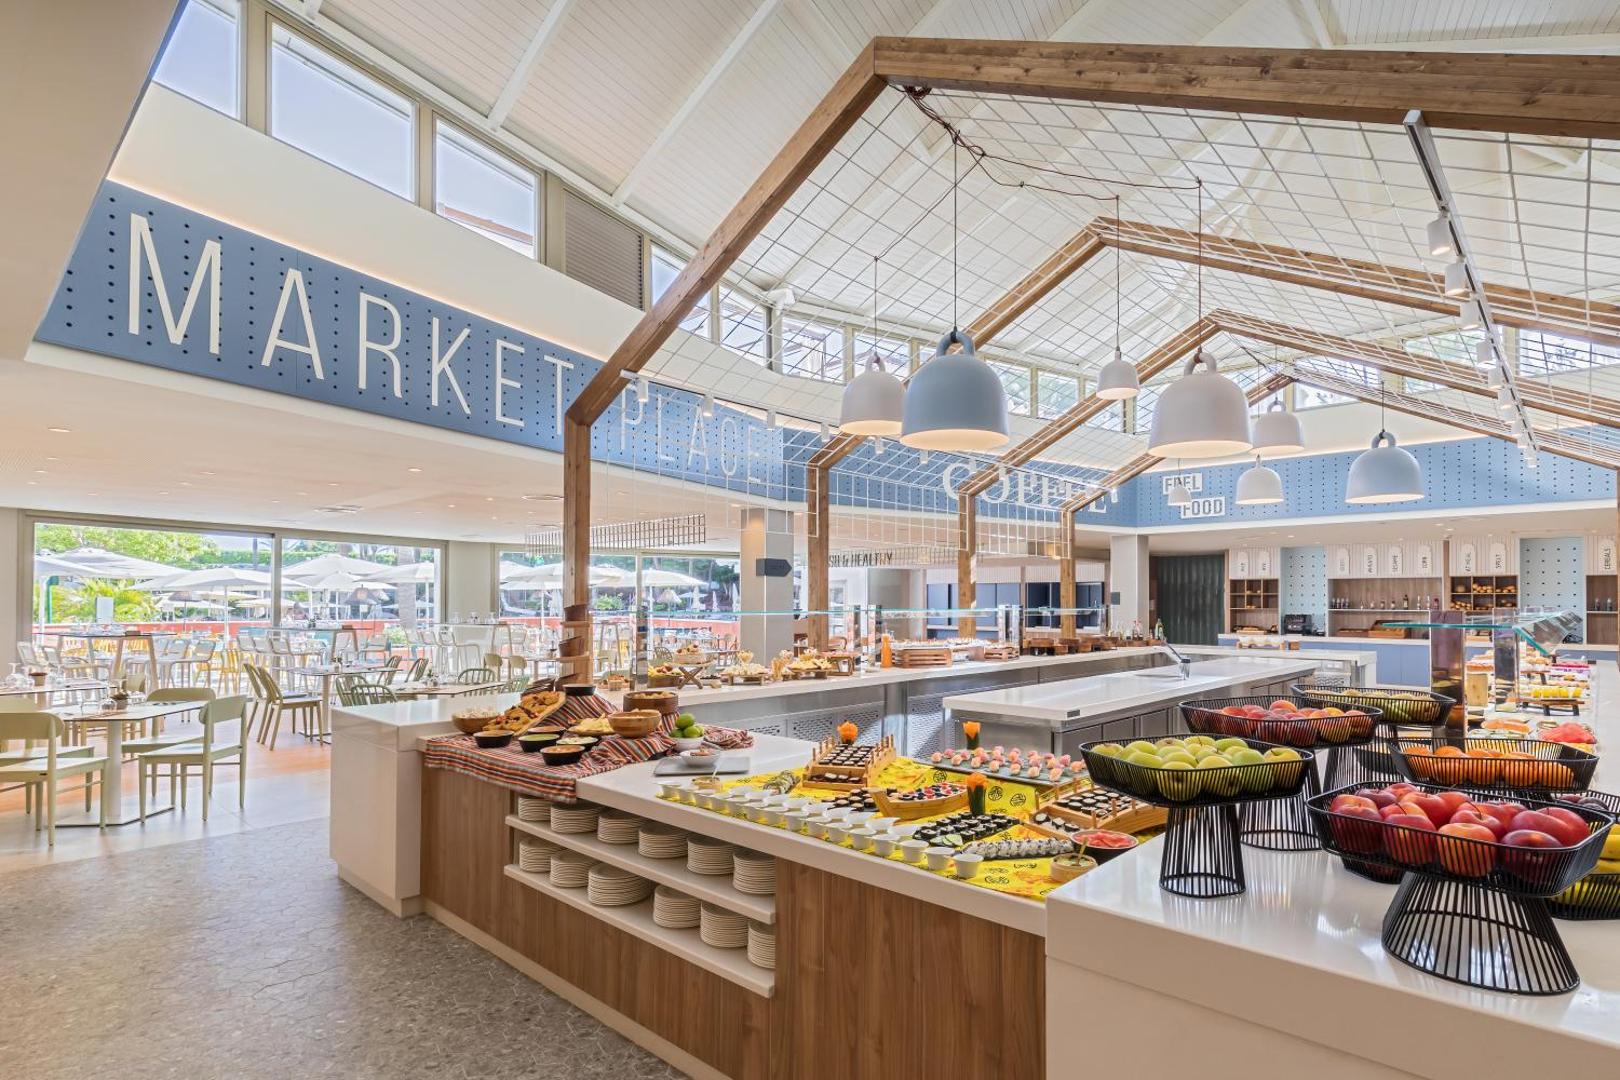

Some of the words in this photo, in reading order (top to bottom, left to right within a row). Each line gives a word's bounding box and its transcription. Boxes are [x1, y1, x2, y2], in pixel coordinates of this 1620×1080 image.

[128, 213, 575, 436] MARKET
[620, 383, 763, 483] PLACE
[1183, 499, 1223, 517] FOOD
